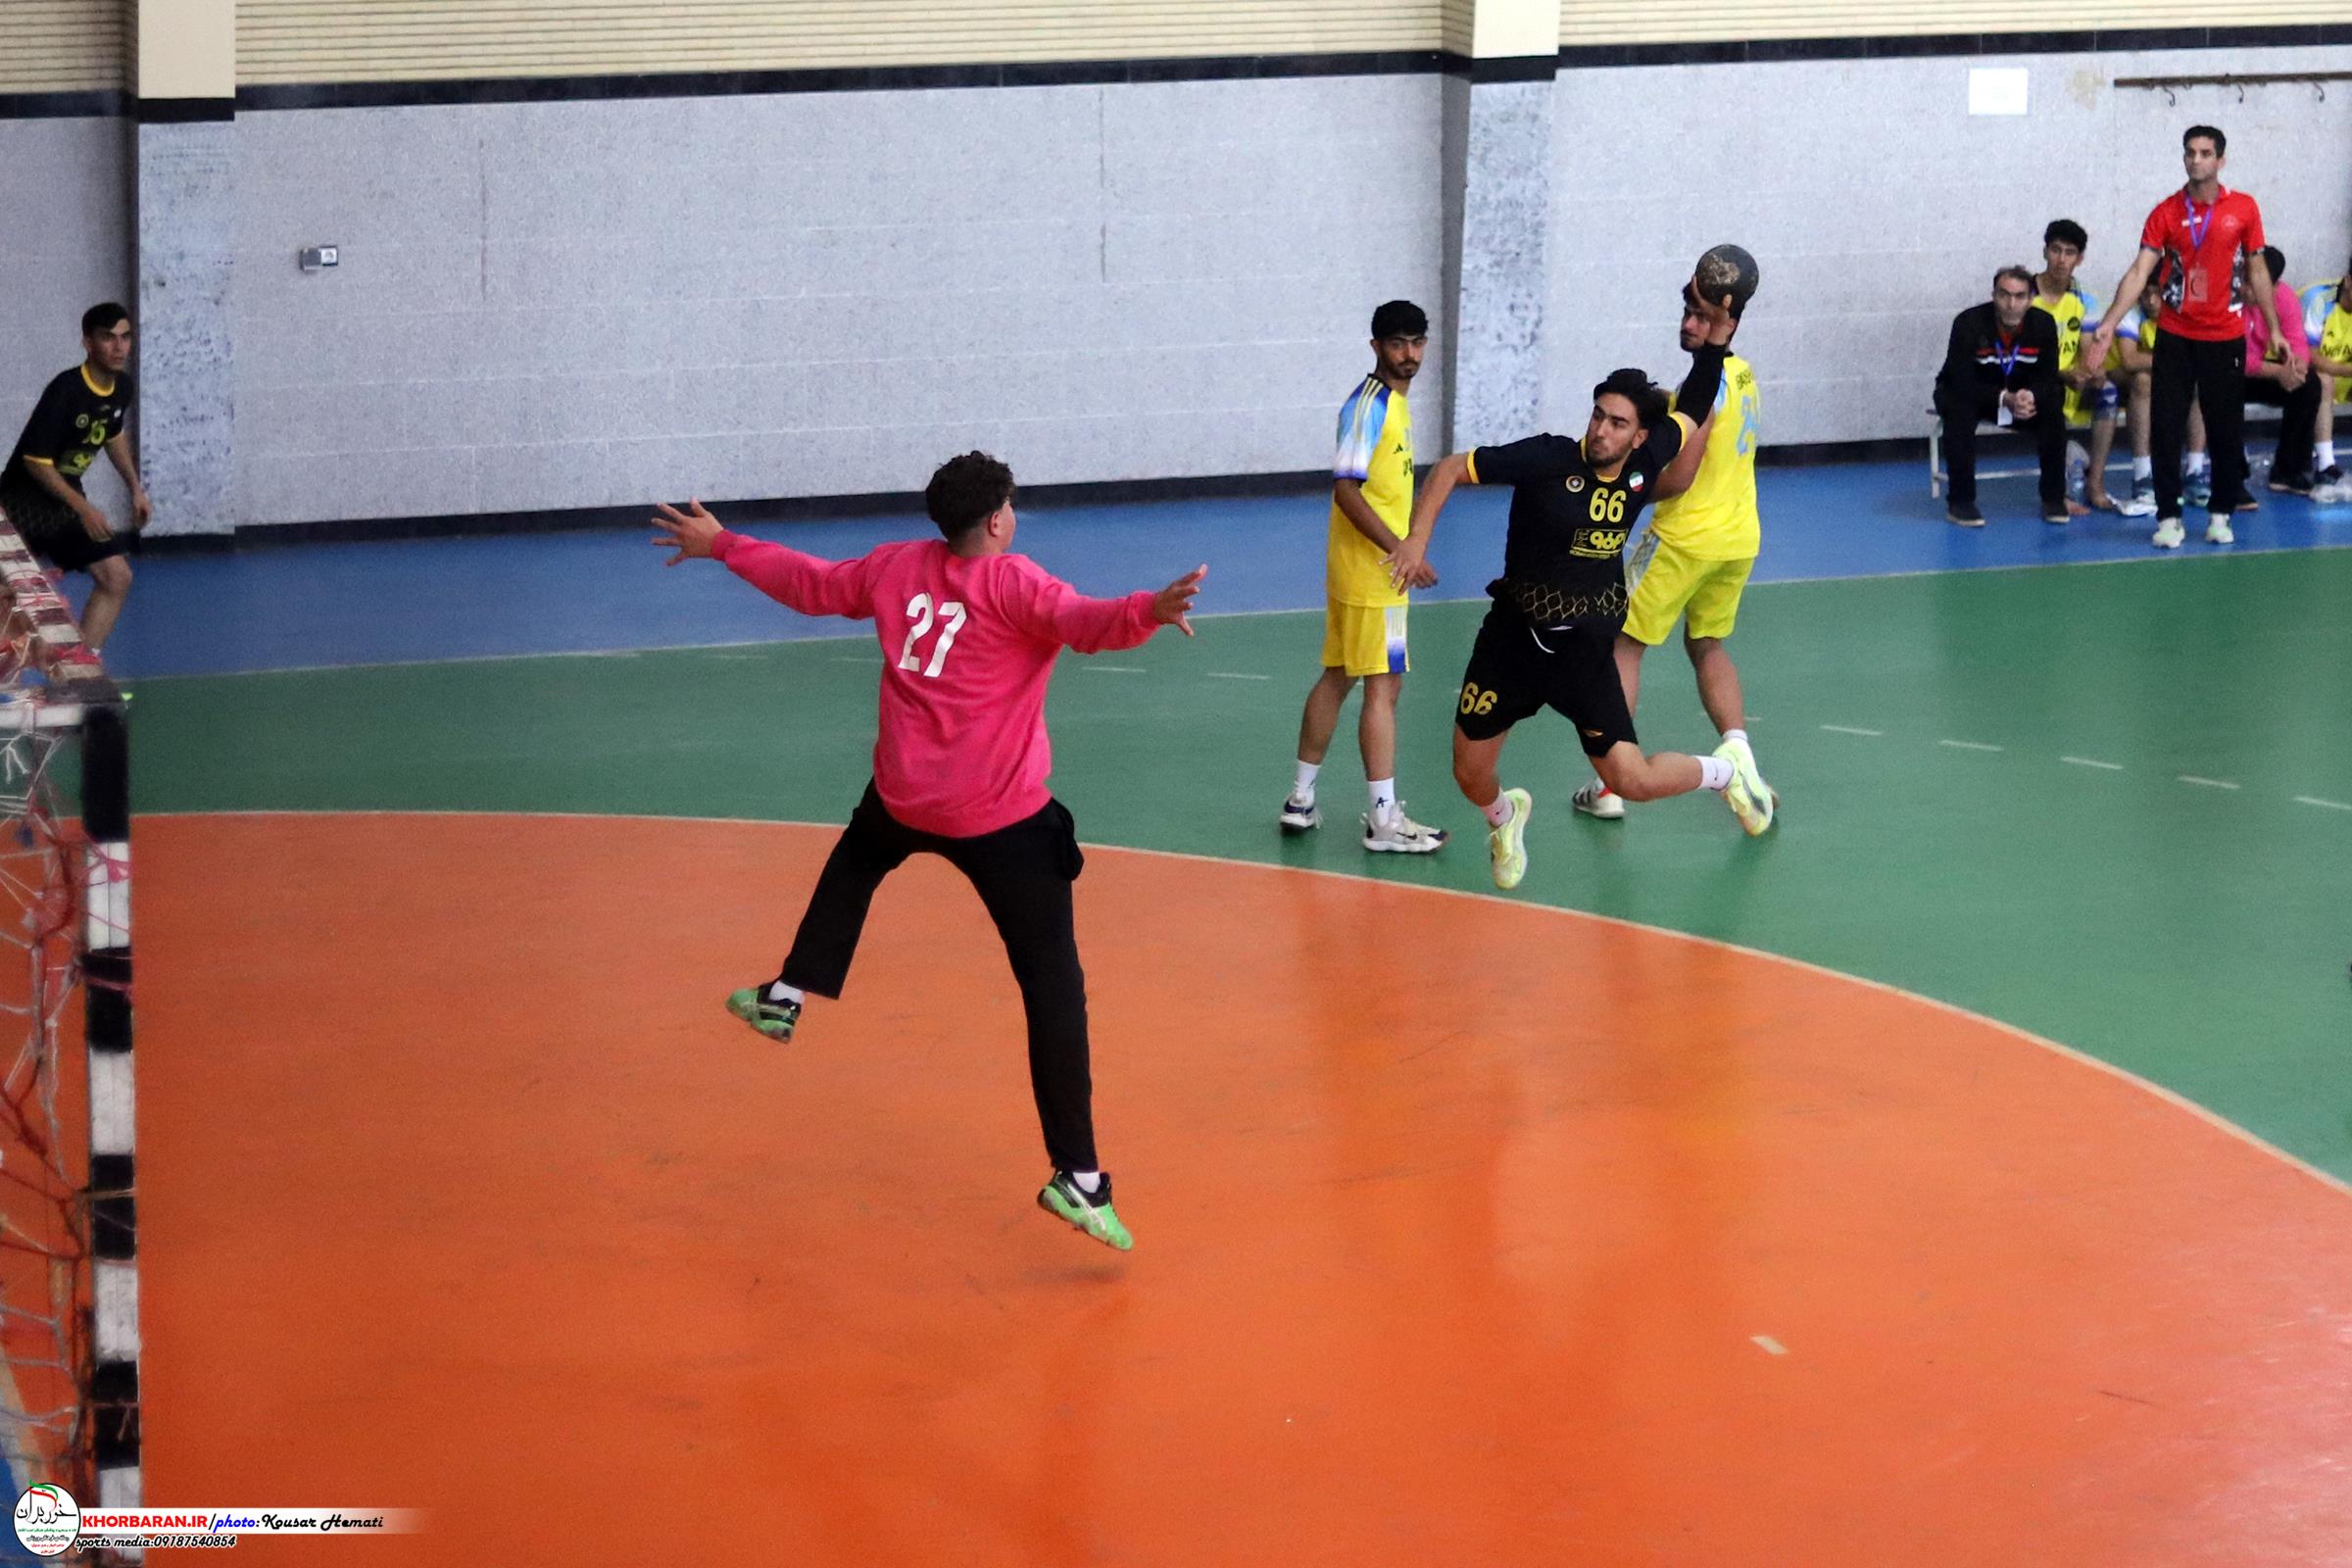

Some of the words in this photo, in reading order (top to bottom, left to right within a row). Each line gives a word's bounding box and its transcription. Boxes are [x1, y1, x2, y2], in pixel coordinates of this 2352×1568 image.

[1590, 487, 1627, 522] 66
[898, 592, 967, 677] 27
[1460, 681, 1497, 714] 66
